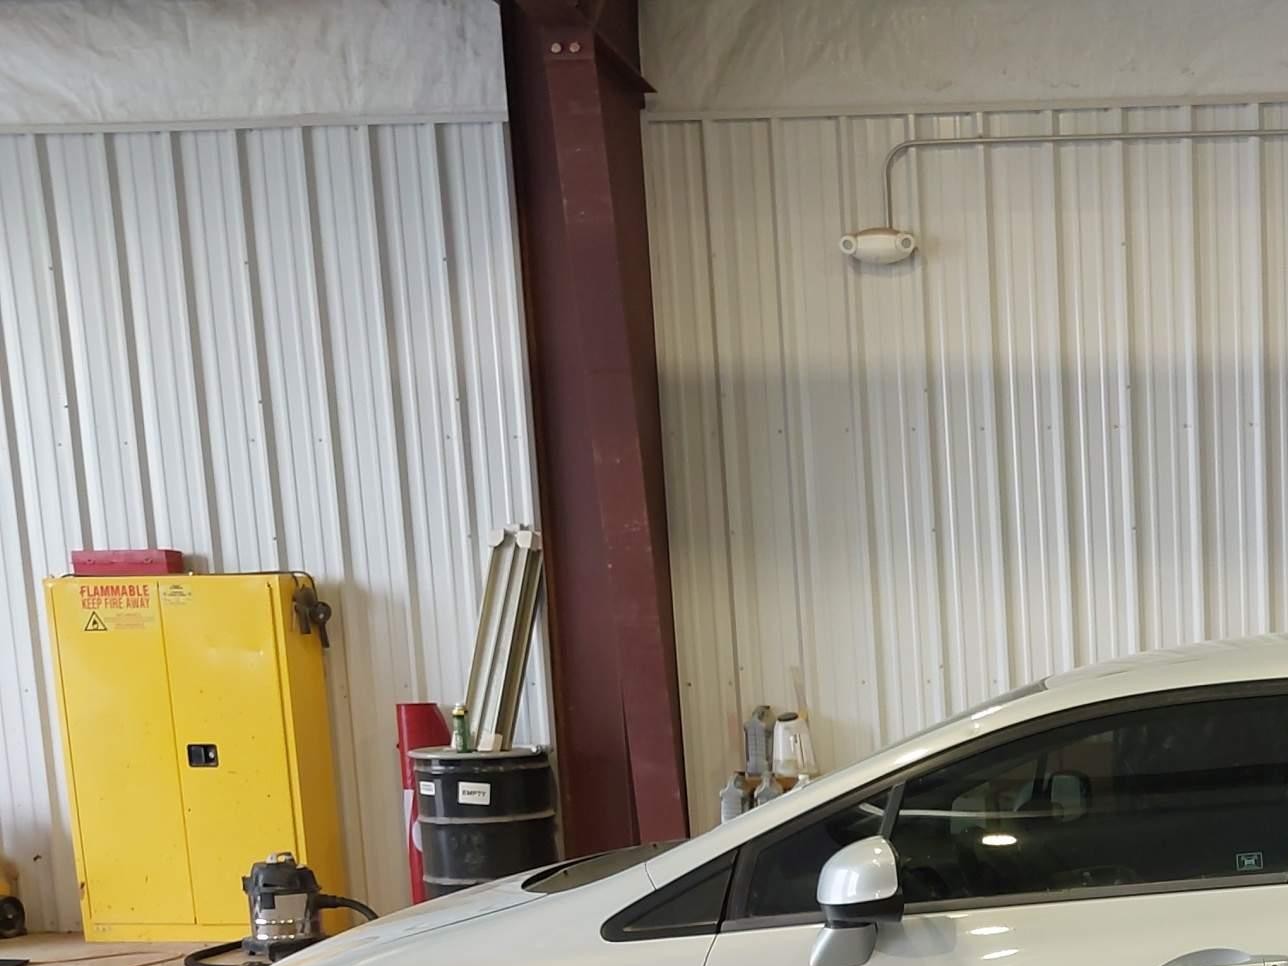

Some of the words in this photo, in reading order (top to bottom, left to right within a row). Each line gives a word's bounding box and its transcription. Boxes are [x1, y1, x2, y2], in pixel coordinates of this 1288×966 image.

[80, 585, 150, 597] FLAMMABLE
[81, 599, 102, 609] KEEP
[104, 599, 123, 609] FIRE
[126, 598, 150, 609] AWAY
[462, 789, 487, 797] EMPTY
